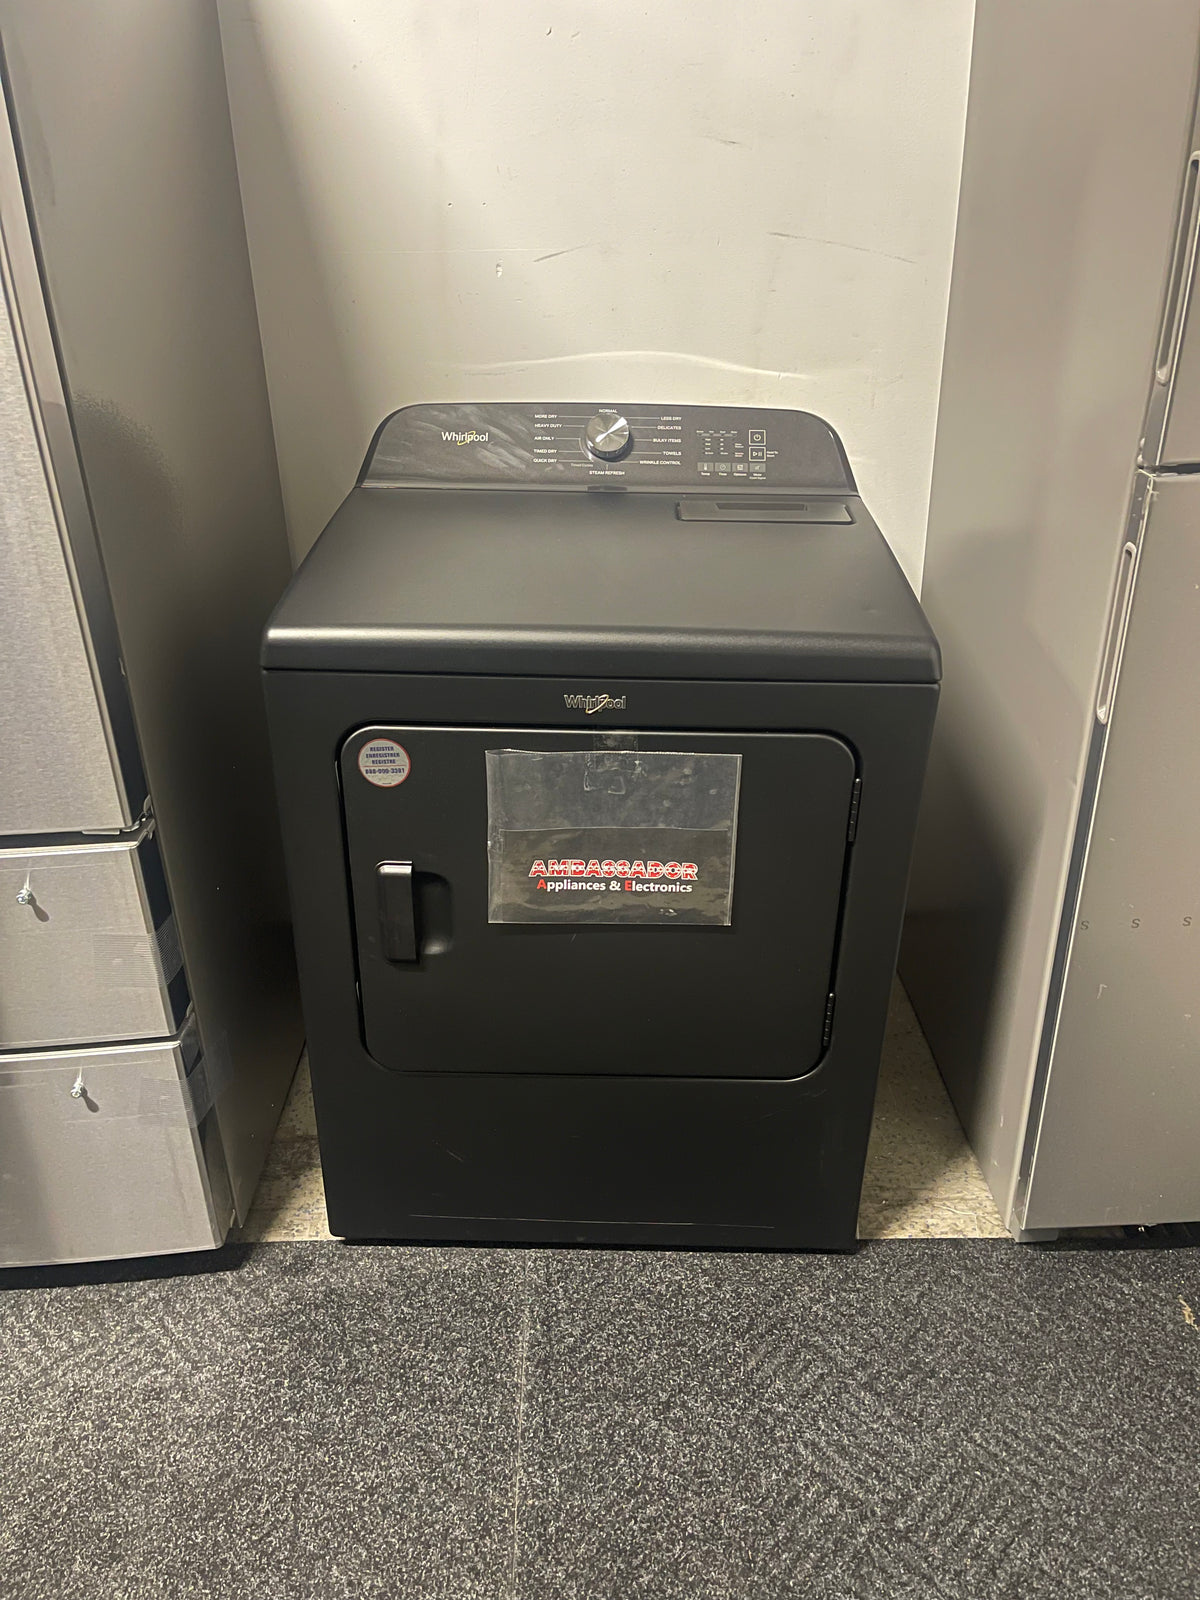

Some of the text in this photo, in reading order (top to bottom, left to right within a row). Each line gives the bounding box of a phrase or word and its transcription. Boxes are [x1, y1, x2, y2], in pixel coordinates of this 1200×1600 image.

[441, 430, 489, 446] Whirlpool
[563, 694, 627, 714] Whirlpool
[528, 859, 699, 881] AMBASSADOR
[536, 879, 693, 893] Appliances & Electronics
